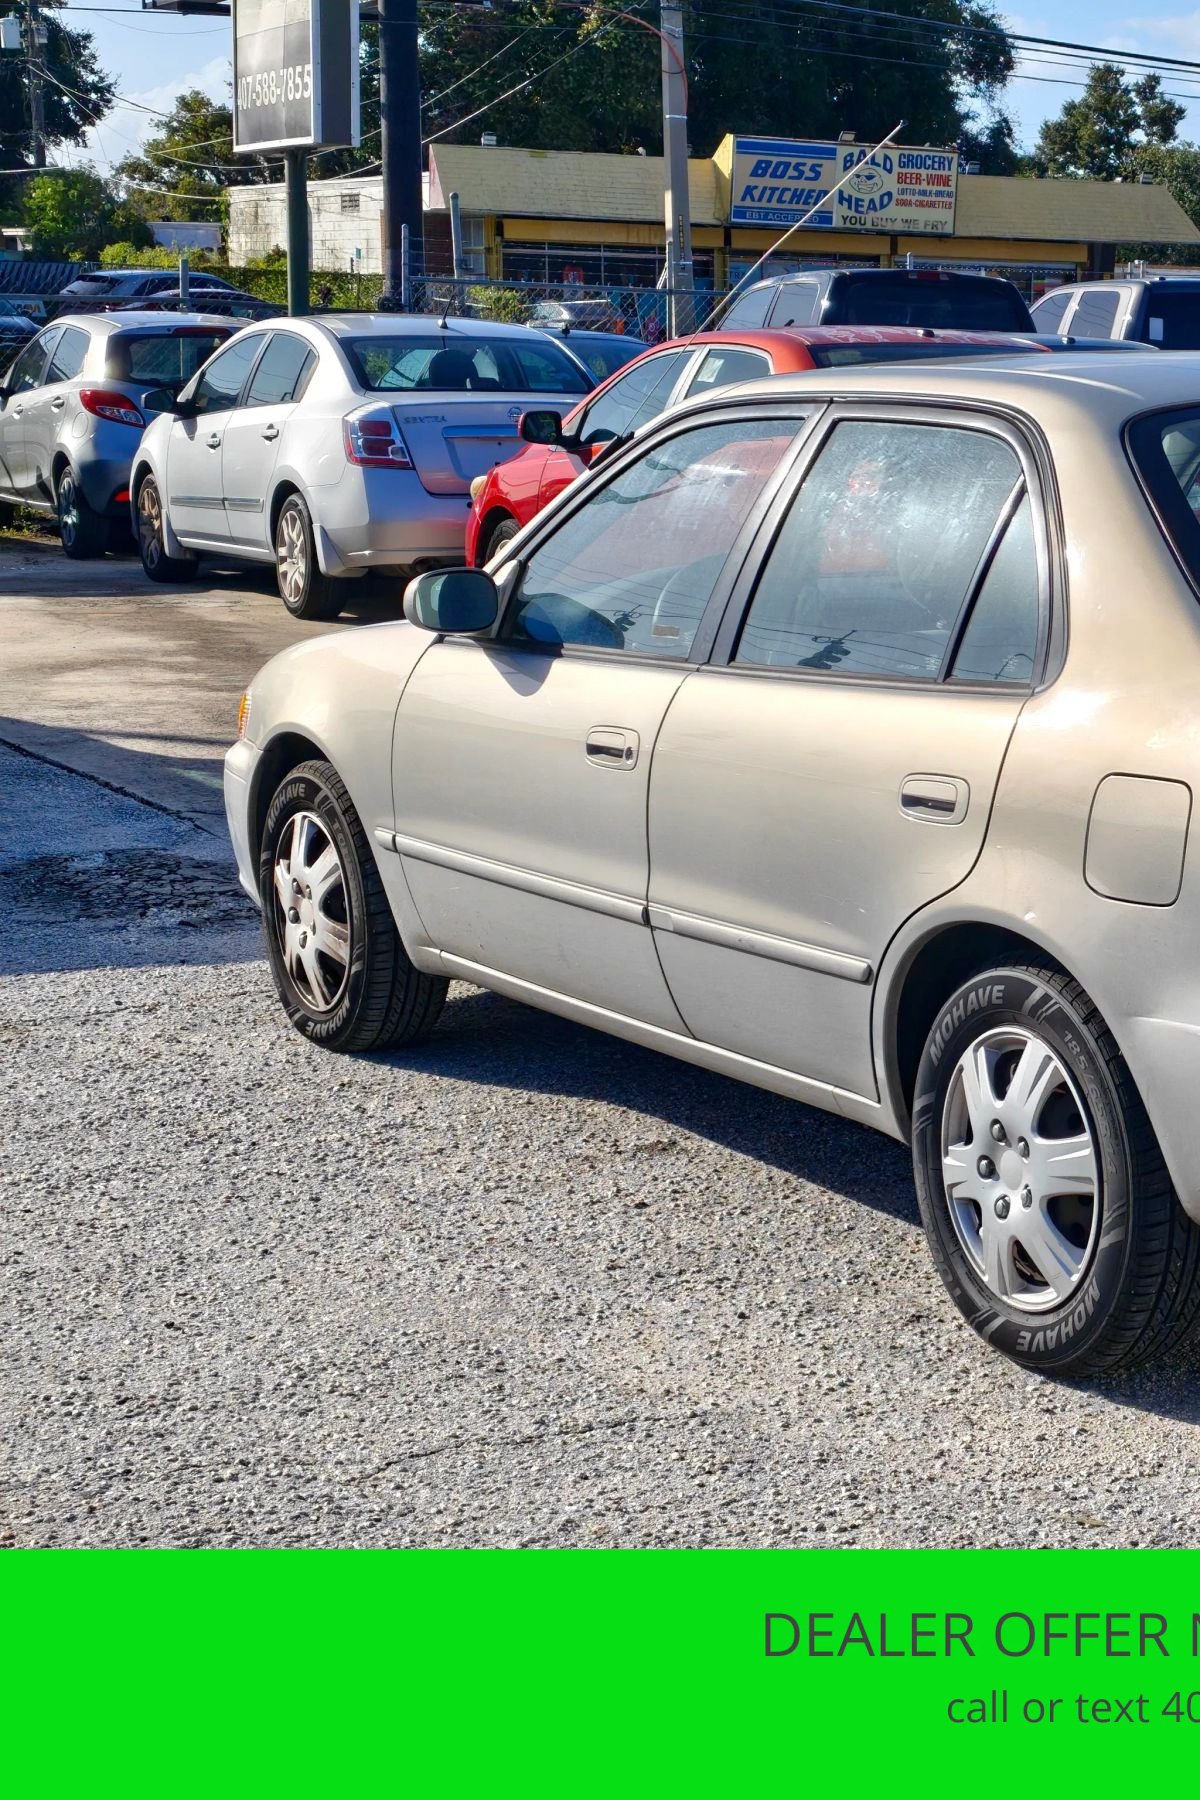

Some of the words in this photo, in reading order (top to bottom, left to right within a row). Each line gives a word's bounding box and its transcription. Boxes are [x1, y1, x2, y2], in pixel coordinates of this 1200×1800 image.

[237, 63, 311, 110] 407-588-7855
[749, 159, 824, 181] BOSS
[843, 149, 894, 175] BALD
[897, 152, 954, 171] GROCERY
[838, 189, 893, 214] HEAD
[746, 211, 765, 219] EBT
[841, 215, 867, 226] YOU
[924, 220, 948, 231] FRY
[268, 783, 306, 833] MOHAVE
[305, 992, 350, 1039] MOHAVE
[930, 984, 1005, 1067] MOHAVE
[1016, 1275, 1101, 1353] MOHAVE
